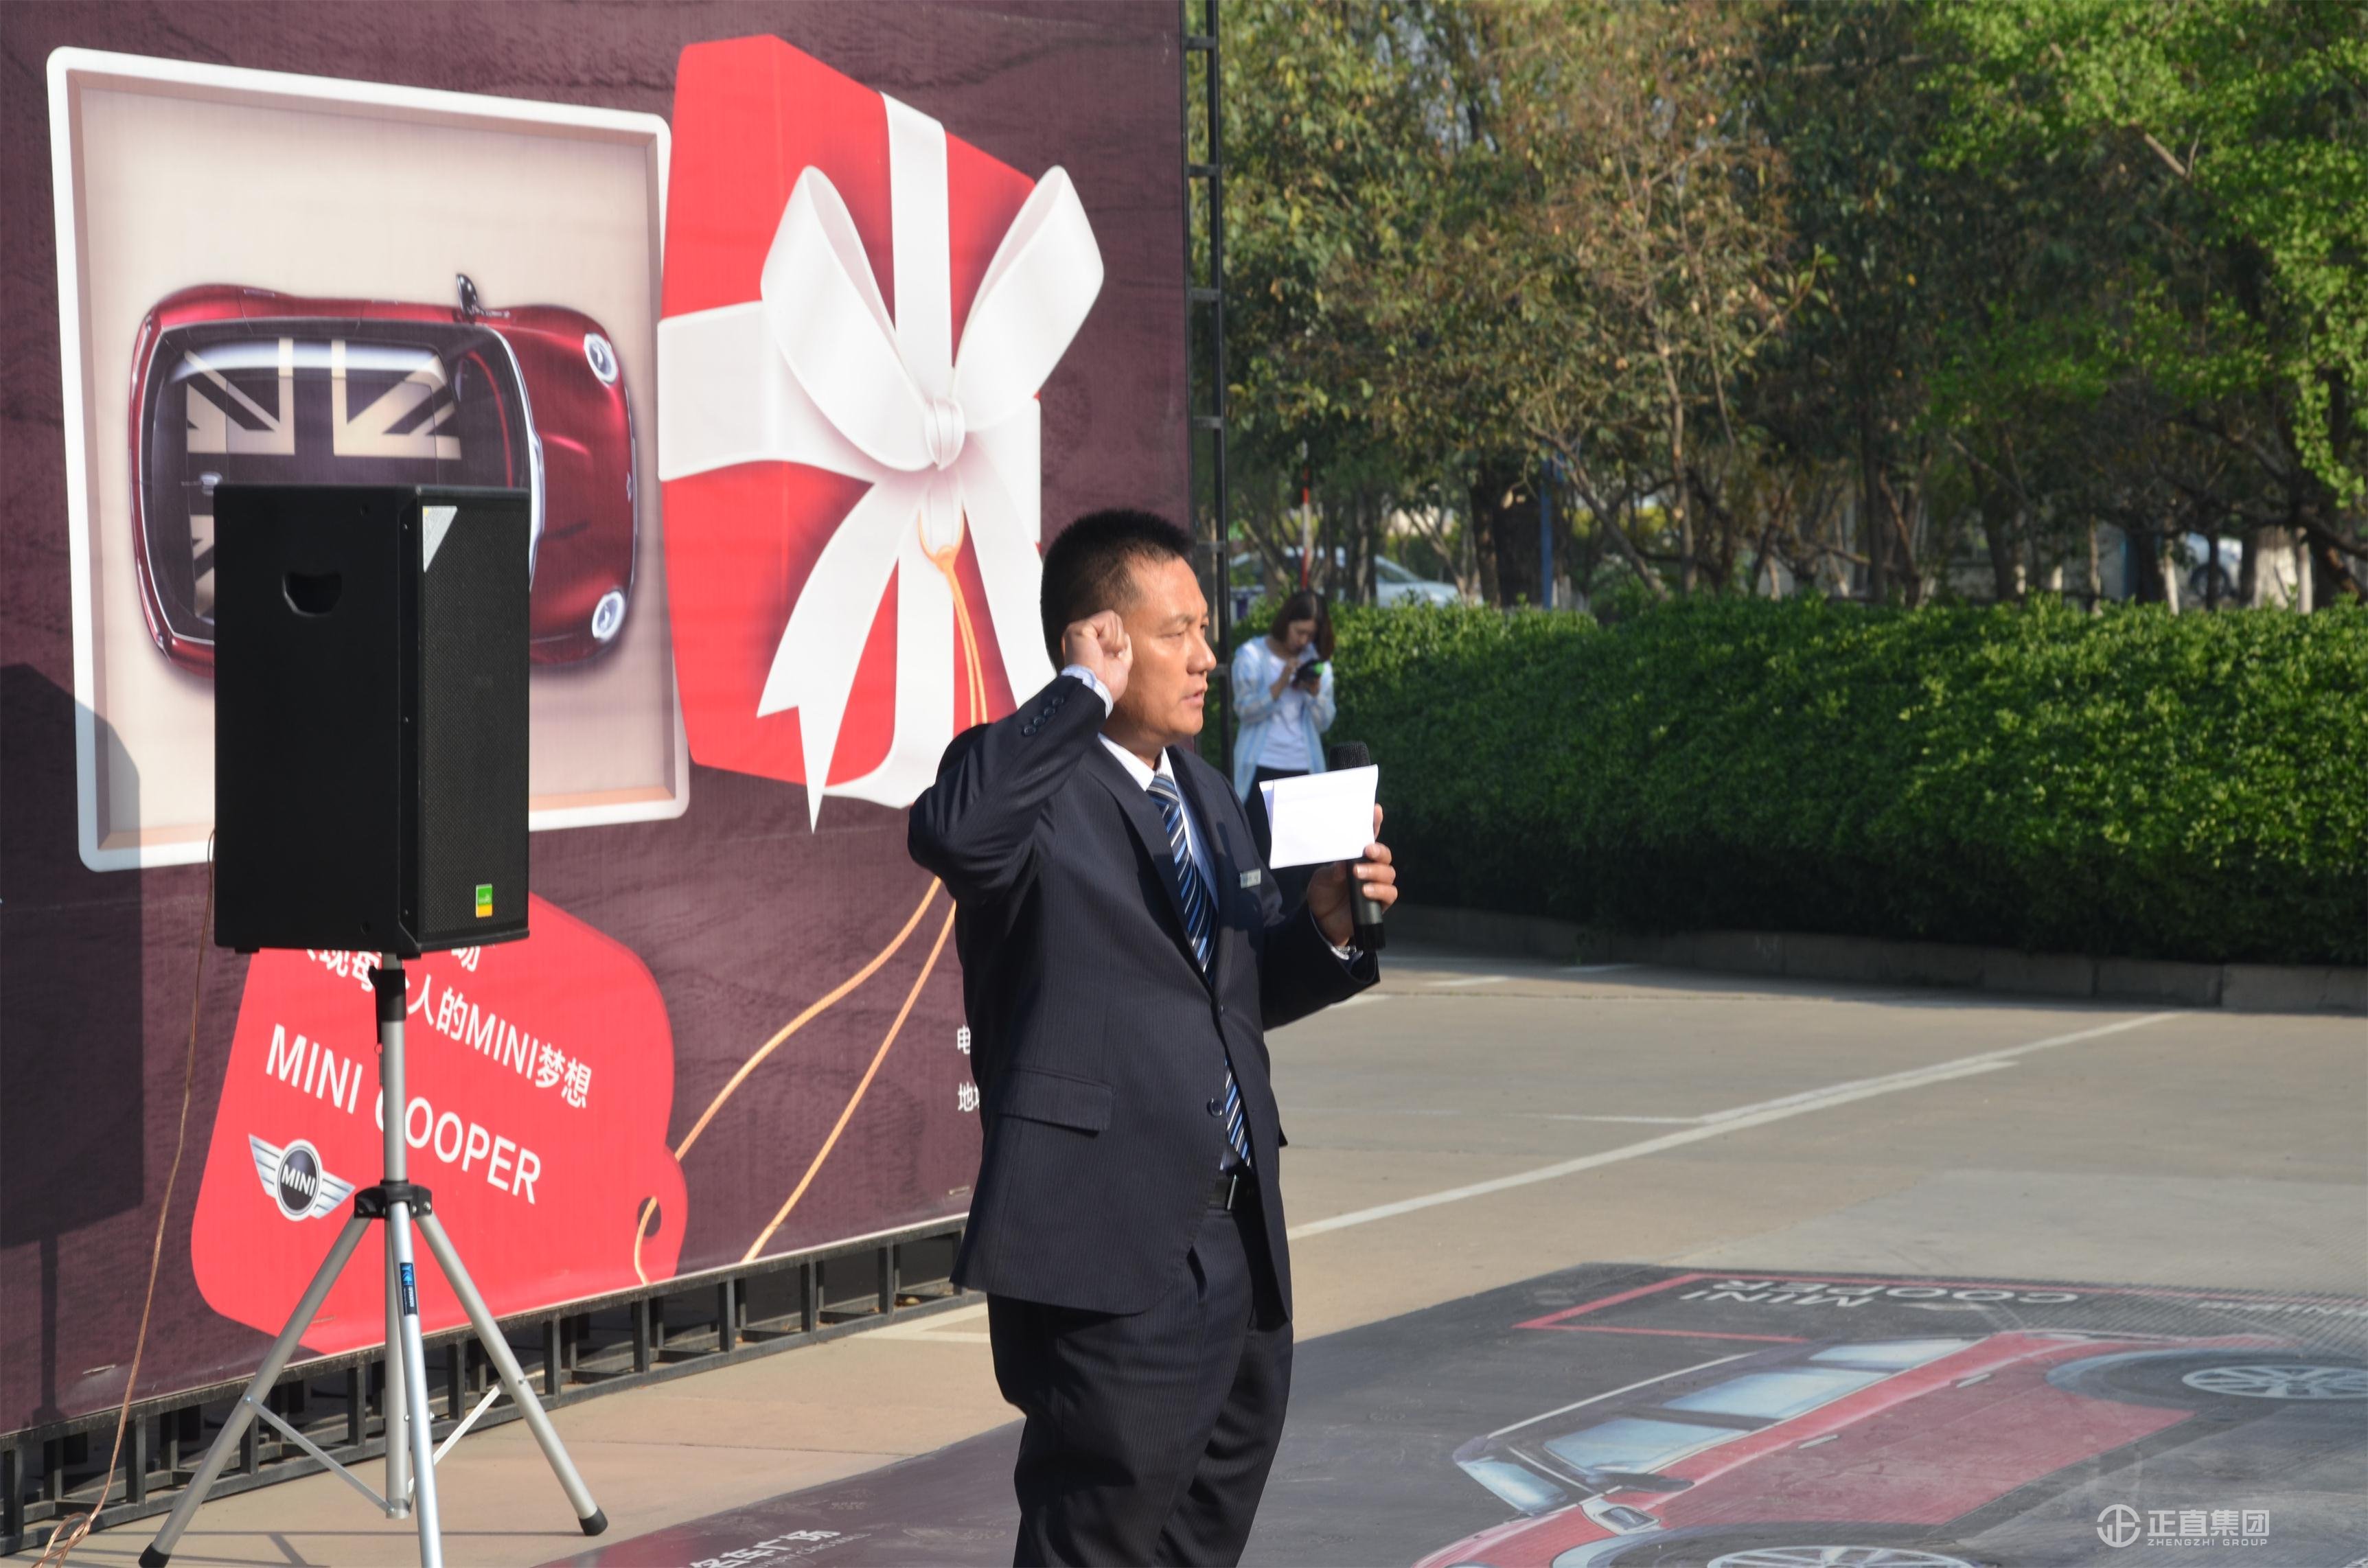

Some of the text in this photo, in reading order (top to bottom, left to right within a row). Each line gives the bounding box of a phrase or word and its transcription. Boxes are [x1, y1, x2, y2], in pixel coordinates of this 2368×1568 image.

[306, 948, 592, 1109] 现每人的MINI梦想
[265, 1023, 363, 1114] MINI
[281, 1163, 317, 1197] MINI
[1679, 1290, 1875, 1307] MINI
[1712, 1280, 2078, 1304] COOPER
